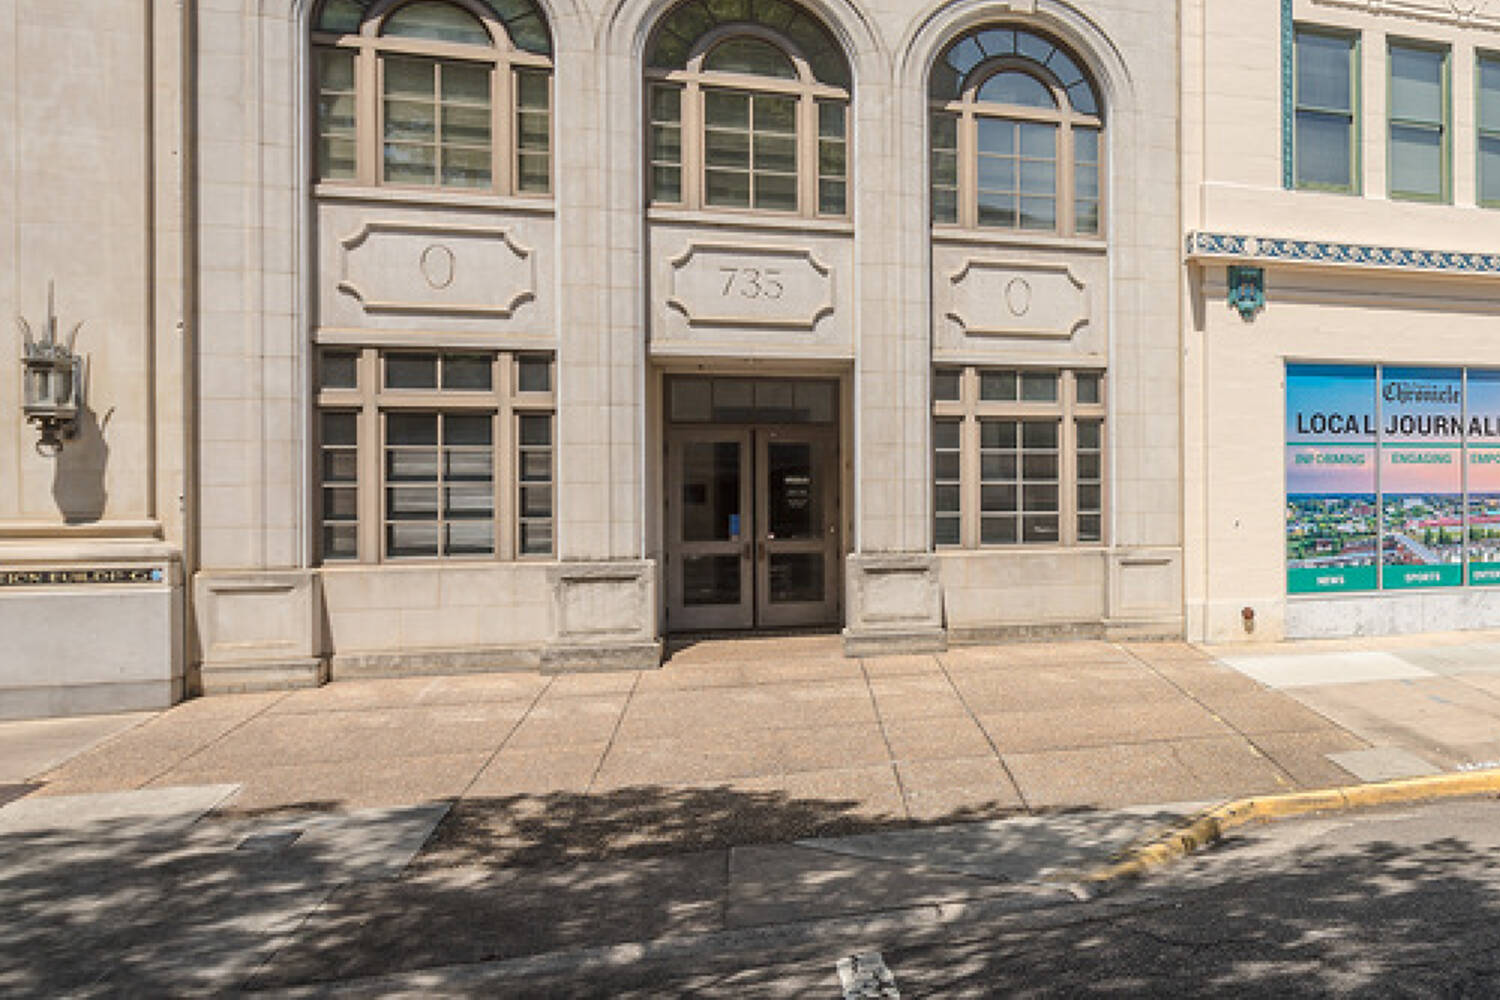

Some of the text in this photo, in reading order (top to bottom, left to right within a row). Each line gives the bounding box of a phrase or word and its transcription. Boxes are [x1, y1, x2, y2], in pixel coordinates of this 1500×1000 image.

[719, 268, 784, 299] 735
[1297, 412, 1376, 435] LOCAL
[1295, 453, 1366, 464] INFORMING
[1391, 453, 1452, 464] ENGAGING
